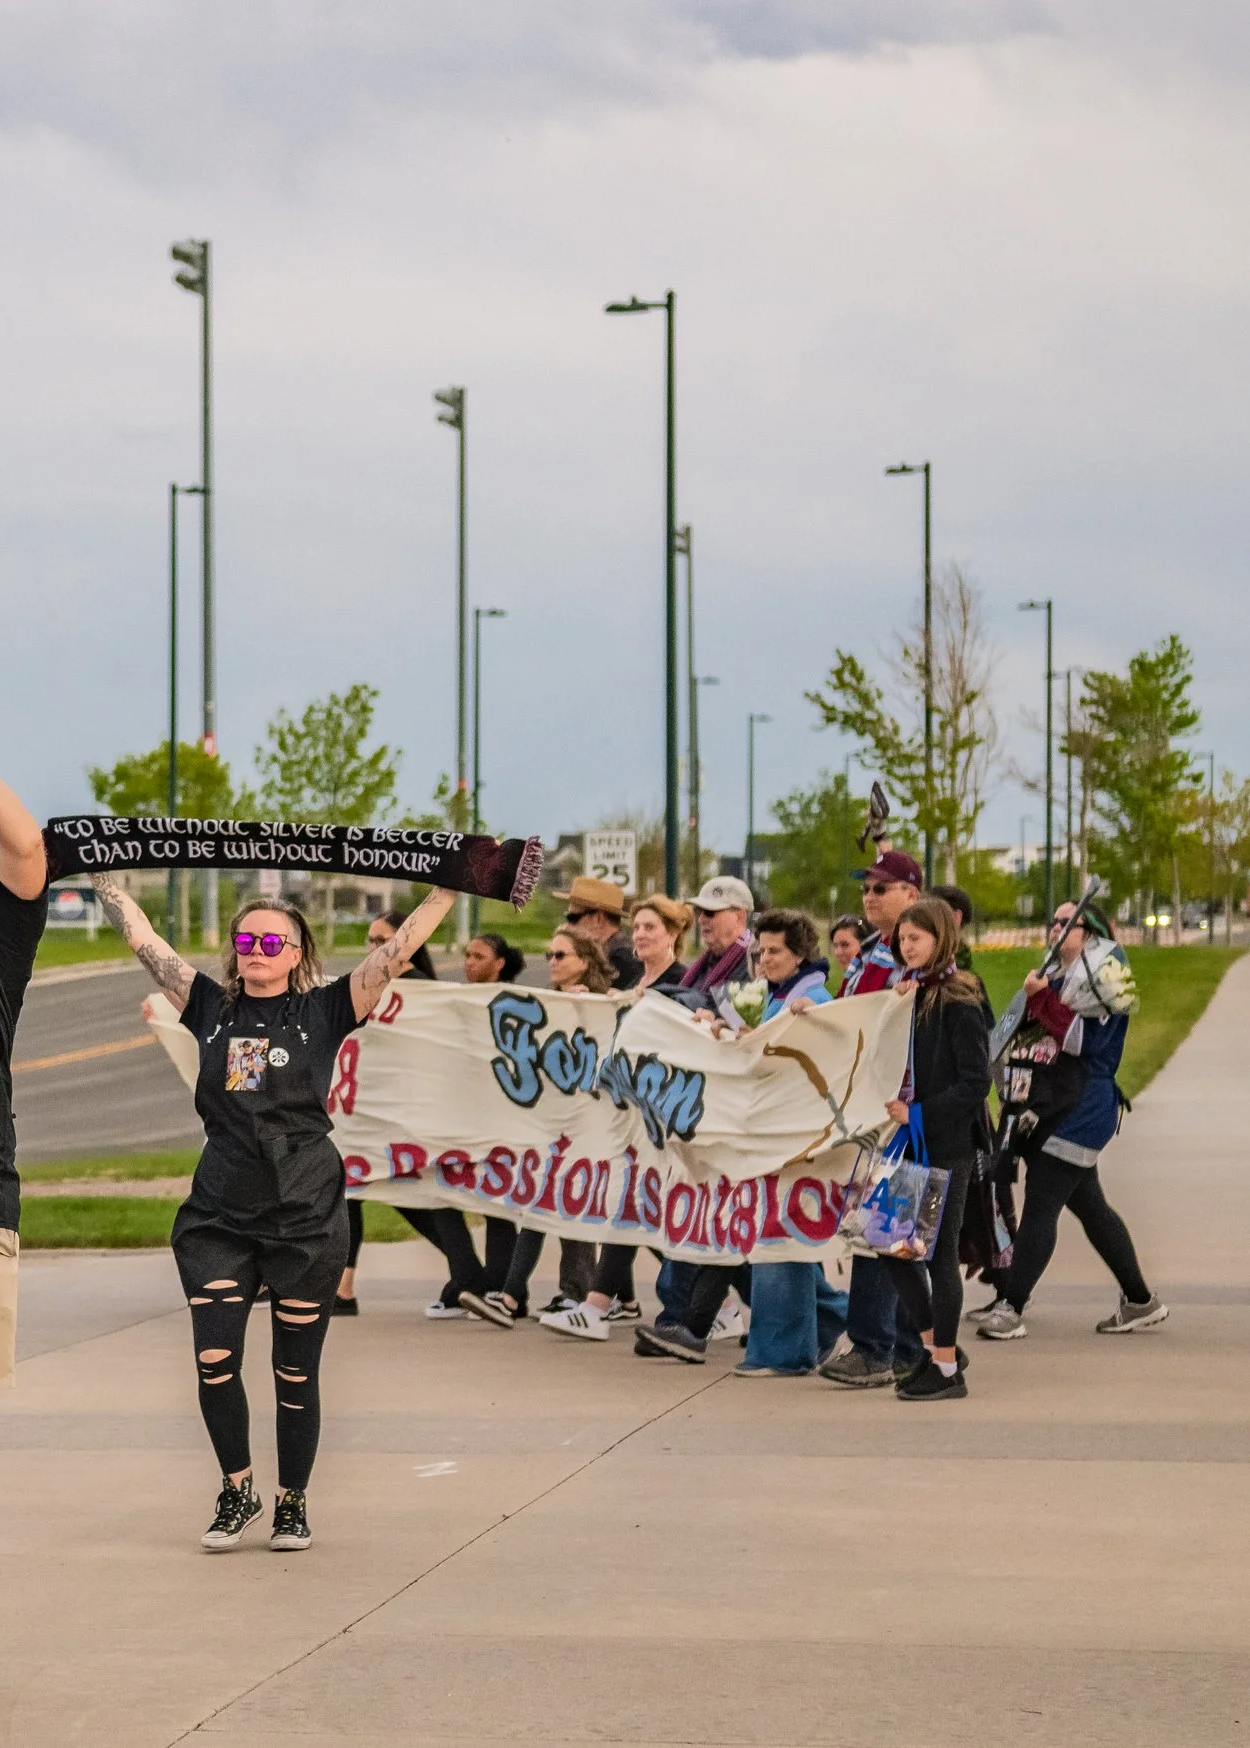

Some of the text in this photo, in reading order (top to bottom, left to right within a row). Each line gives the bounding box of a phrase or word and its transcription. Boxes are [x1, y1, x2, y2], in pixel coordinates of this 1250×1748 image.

[100, 817, 131, 836] BE
[259, 820, 337, 839] SILVER
[346, 825, 365, 841] IS
[148, 839, 180, 859] TO
[186, 839, 216, 859] BE
[589, 837, 632, 847] SPEED
[593, 851, 627, 860] LIMIT
[592, 863, 630, 888] 25
